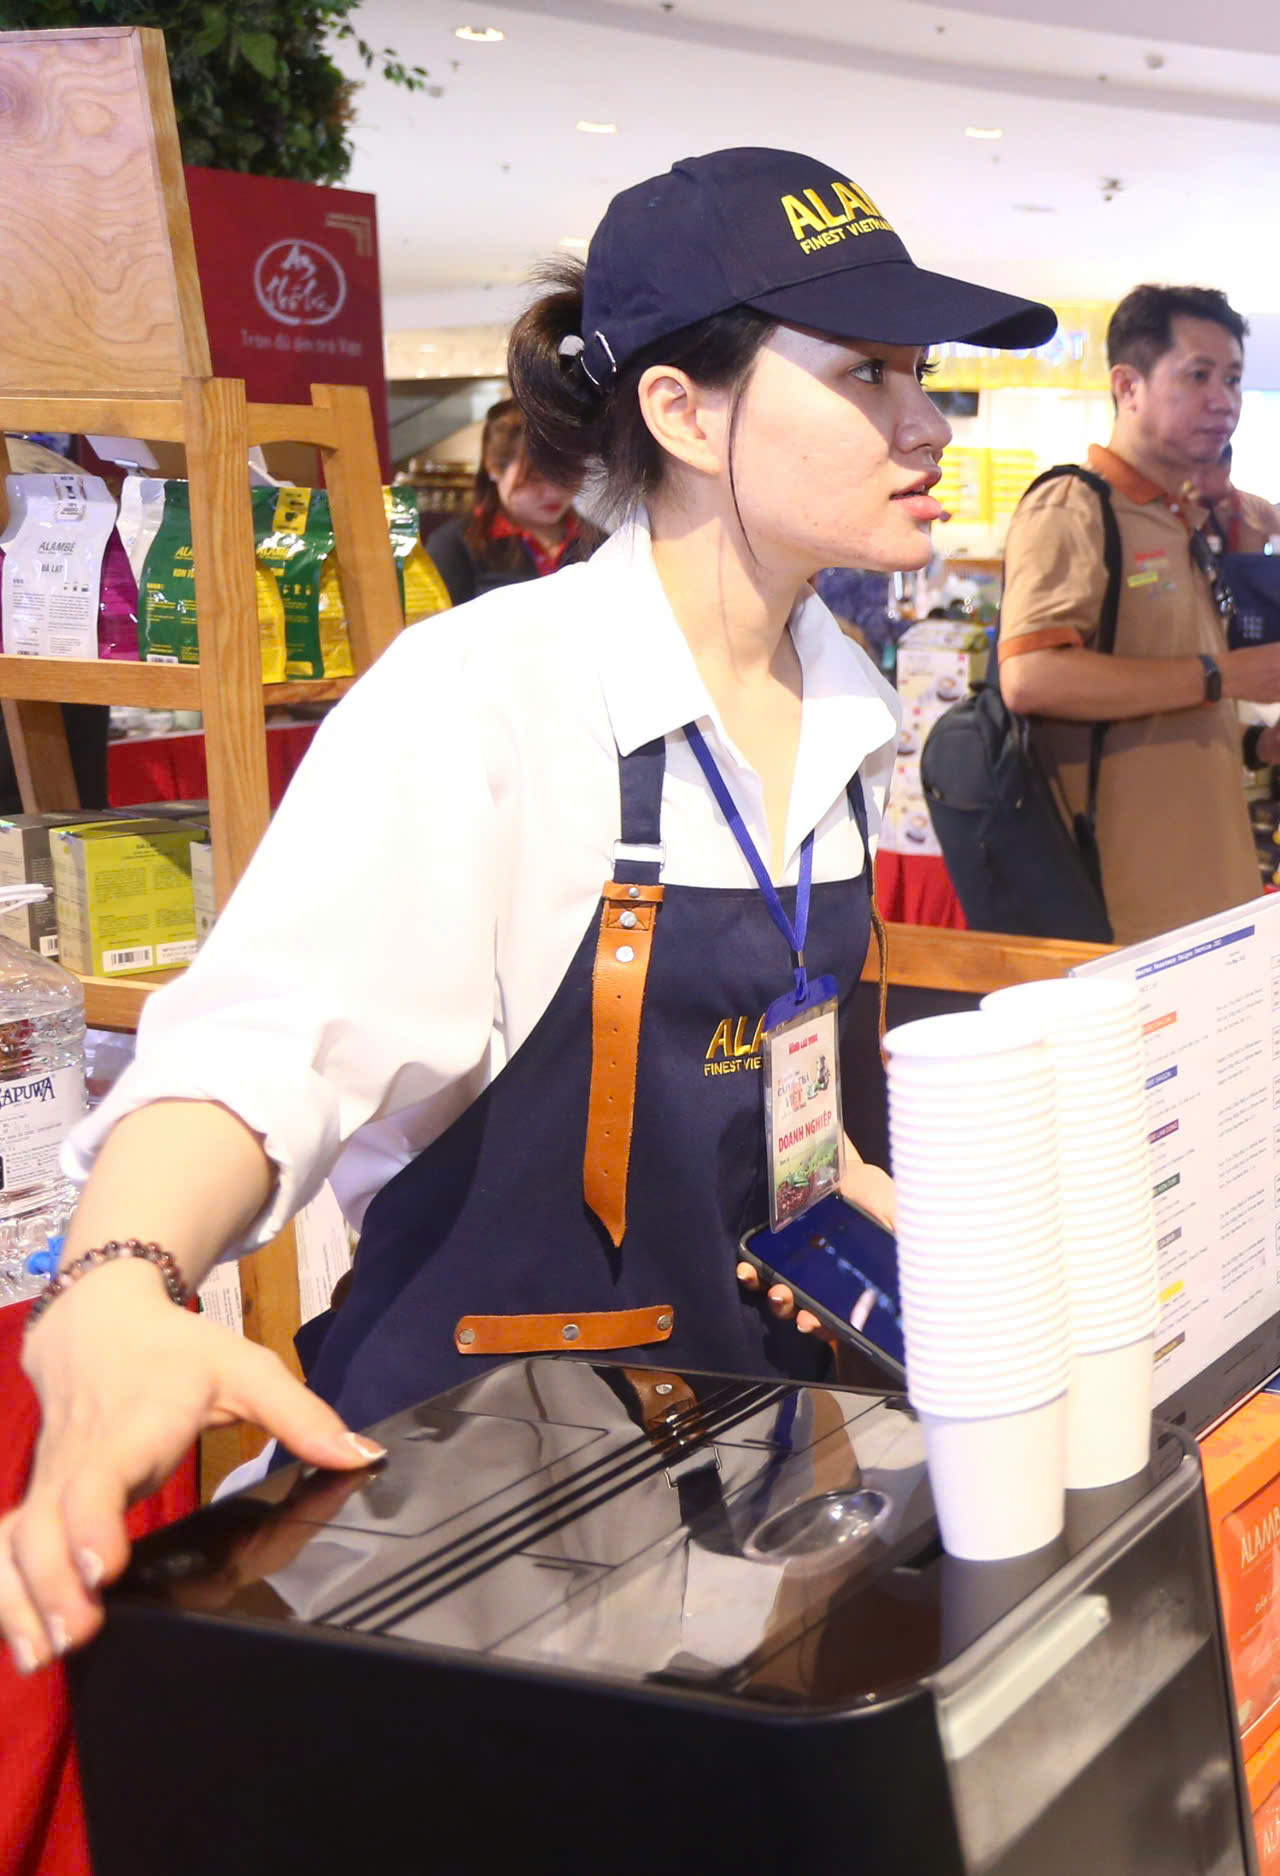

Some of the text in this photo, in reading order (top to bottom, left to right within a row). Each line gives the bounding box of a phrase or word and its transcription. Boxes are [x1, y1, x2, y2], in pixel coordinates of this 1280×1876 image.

[800, 228, 846, 255] FINEST
[704, 1059, 744, 1077] FINEST
[0, 1077, 56, 1106] APUWA
[778, 1110, 832, 1153] DOANH NGHIỆP
